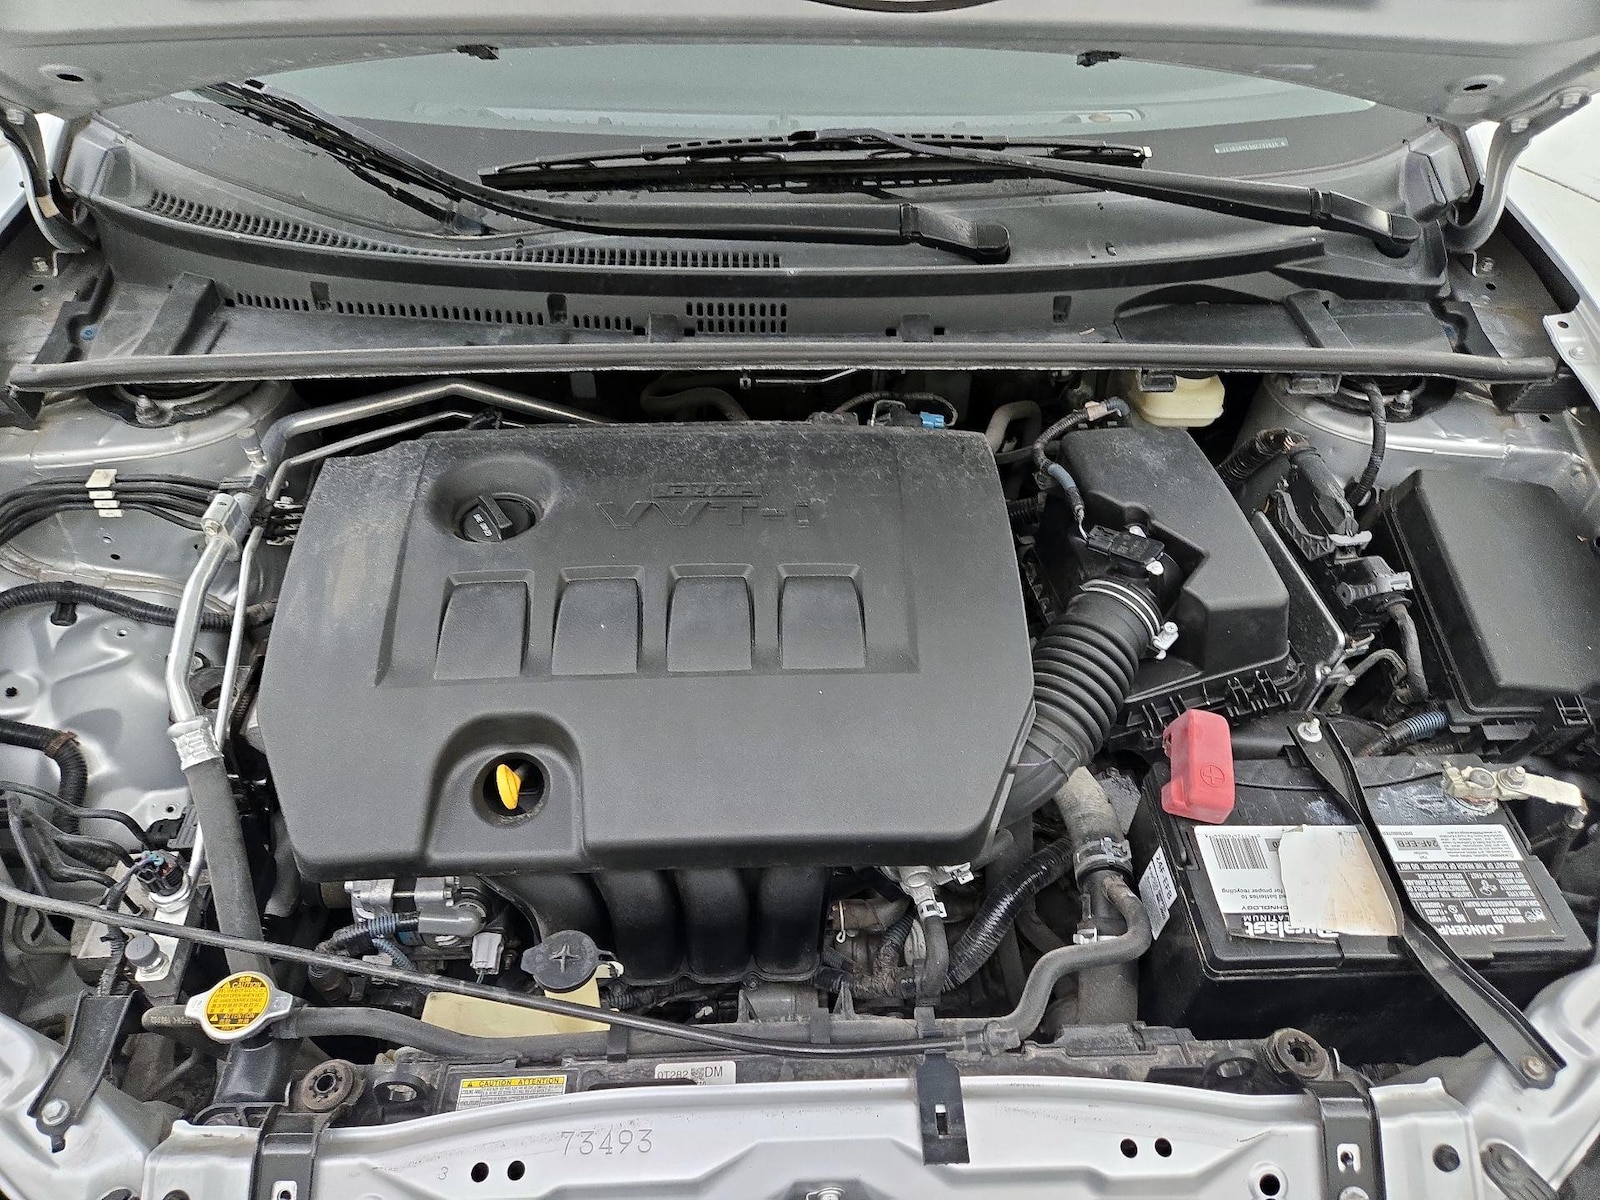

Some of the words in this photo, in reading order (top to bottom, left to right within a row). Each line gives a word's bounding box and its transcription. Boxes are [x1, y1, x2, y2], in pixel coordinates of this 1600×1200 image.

[1397, 840, 1437, 848] 24F-EFB
[1454, 914, 1466, 922] NO
[704, 1066, 722, 1078] DM
[561, 1129, 653, 1156] 73493
[438, 1166, 448, 1180] 3
